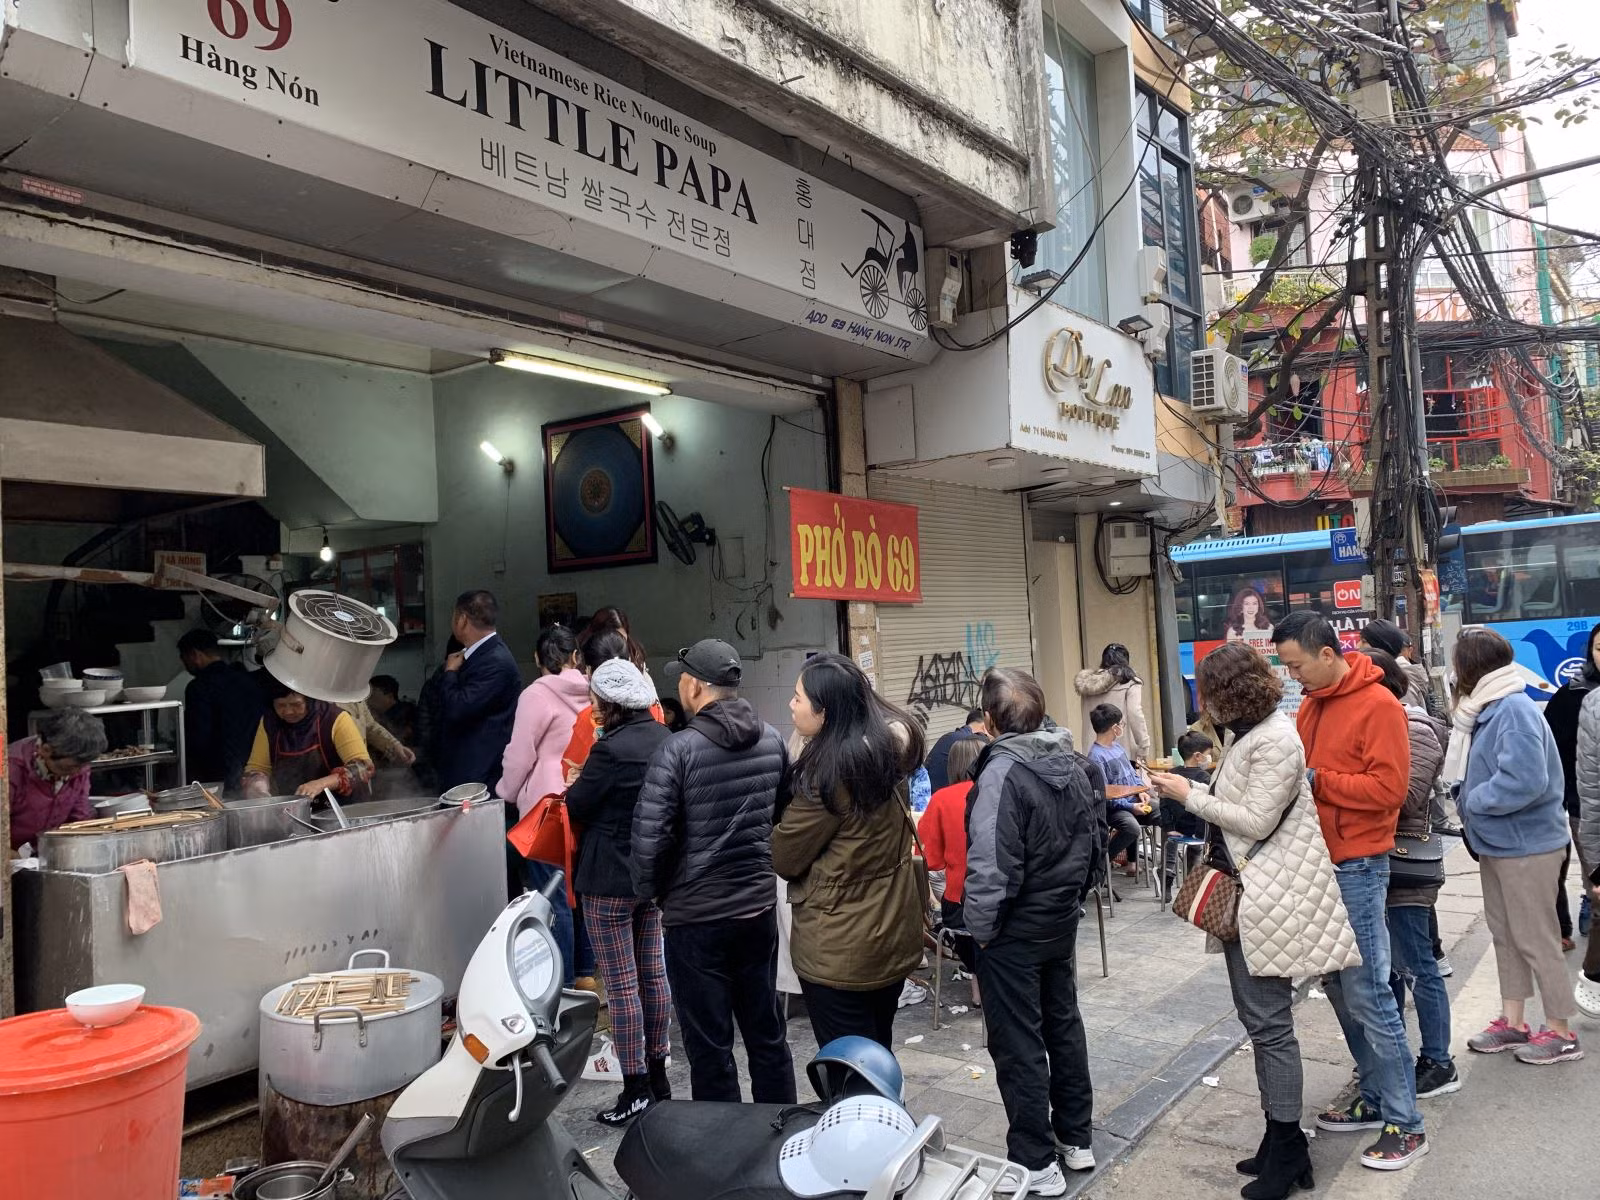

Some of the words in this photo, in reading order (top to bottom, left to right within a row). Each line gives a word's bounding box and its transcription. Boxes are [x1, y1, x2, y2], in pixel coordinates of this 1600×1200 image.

[207, 0, 292, 50] 69
[178, 33, 258, 91] Hàng
[265, 65, 320, 107] Nón
[488, 33, 589, 95] Vietnamese
[593, 81, 627, 114] Rice
[631, 104, 681, 138] Noodle
[684, 125, 717, 157] Soup
[423, 37, 639, 177] LITTLE
[651, 138, 758, 225] PAPA
[480, 137, 570, 199] 베트남
[581, 176, 657, 231] 쌀국수
[667, 208, 731, 258] 전문점
[805, 310, 828, 324] ADD
[831, 318, 847, 330] 69
[846, 322, 874, 340] HANG
[873, 330, 896, 345] NON
[893, 337, 912, 352] STR
[1058, 402, 1120, 431] BOUTIQUE
[1083, 358, 1133, 410] Lan
[797, 502, 847, 588] PHỞ
[852, 515, 883, 590] BÒ
[887, 535, 915, 592] 69
